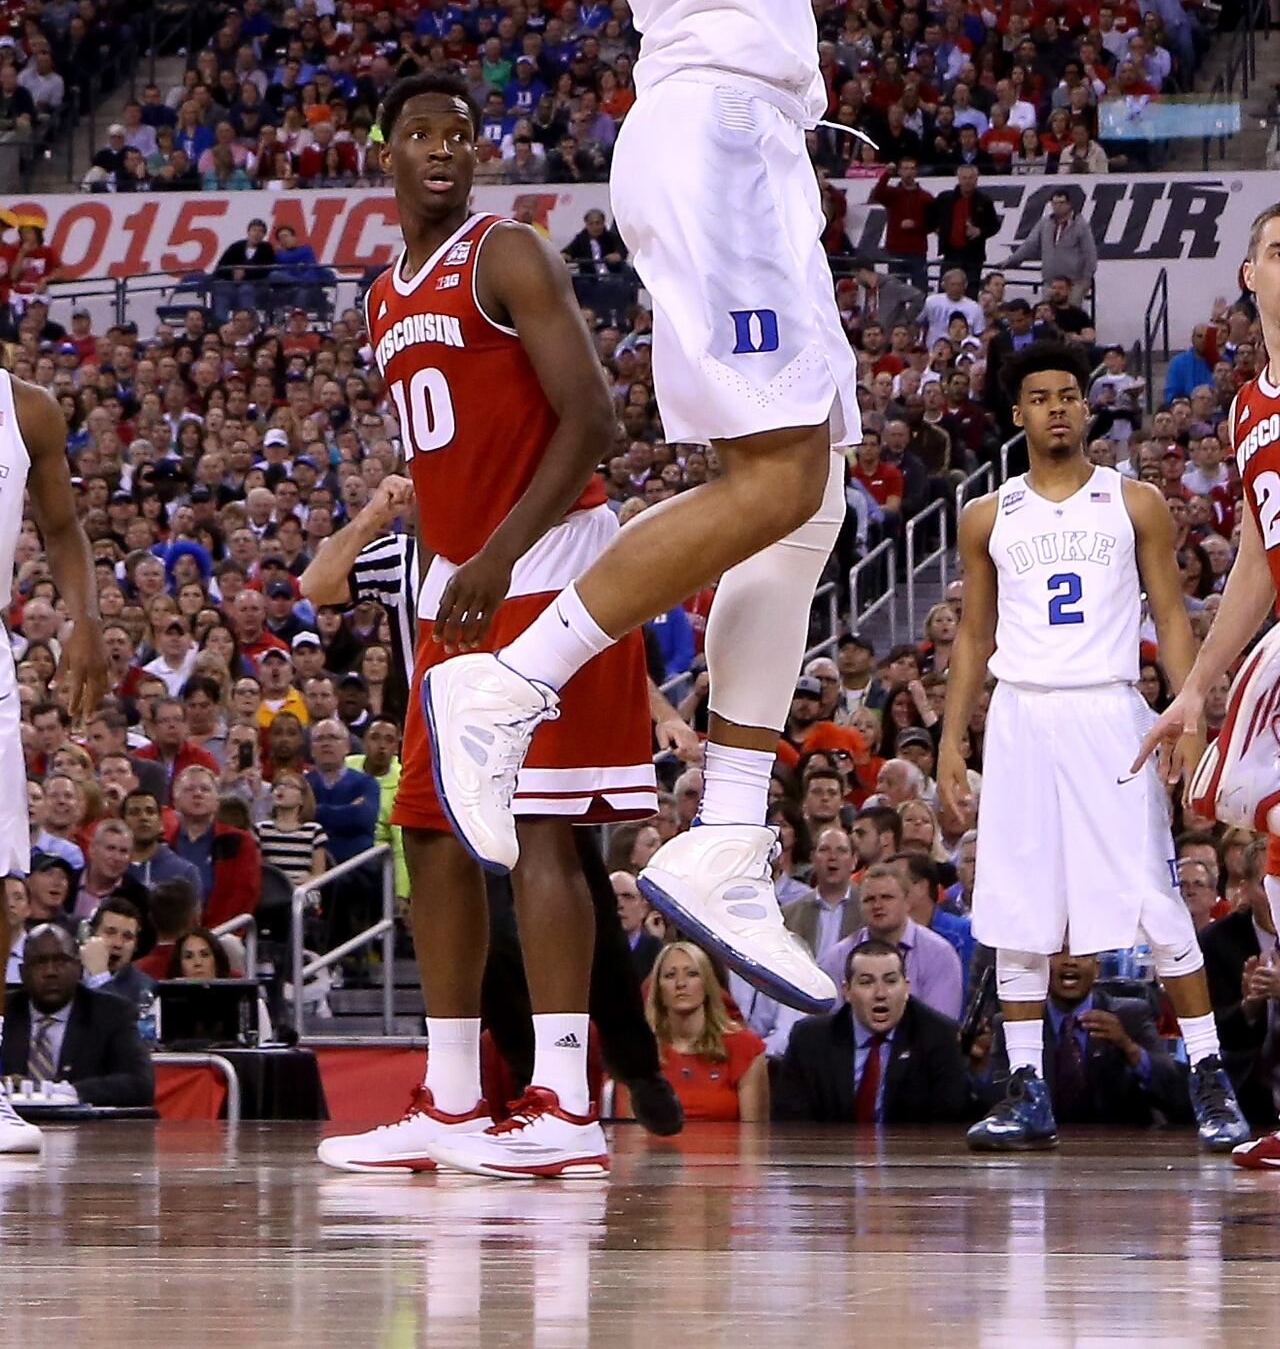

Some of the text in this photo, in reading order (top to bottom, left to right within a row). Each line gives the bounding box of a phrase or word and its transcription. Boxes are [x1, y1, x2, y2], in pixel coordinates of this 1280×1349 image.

[375, 313, 465, 378] WISCONSIN
[390, 367, 456, 461] 10
[1007, 531, 1116, 574] DUKE
[1047, 572, 1084, 625] 2
